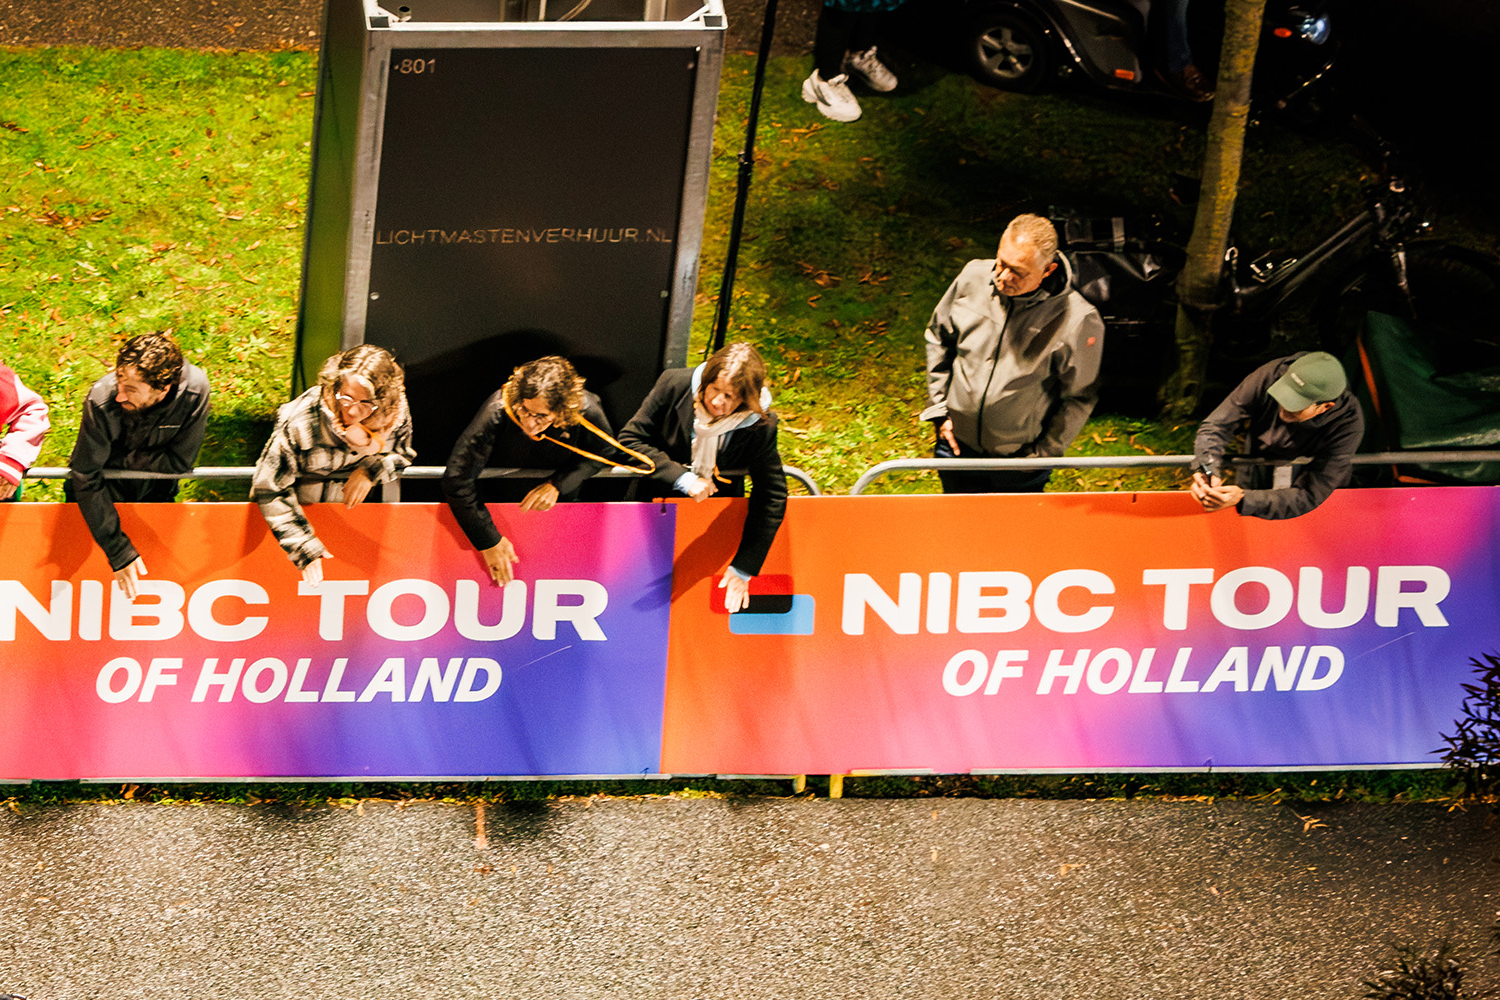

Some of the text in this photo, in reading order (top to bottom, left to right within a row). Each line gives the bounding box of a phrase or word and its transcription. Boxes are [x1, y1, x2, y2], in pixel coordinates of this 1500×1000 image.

[400, 58, 436, 74] 801
[375, 228, 673, 245] LICHTMASTENVERHUUR.NL
[300, 578, 609, 642] TOUR
[841, 565, 1451, 636] NIBC TOUR
[96, 656, 503, 704] OF HOLLAND
[941, 644, 1346, 697] OF HOLLAND
